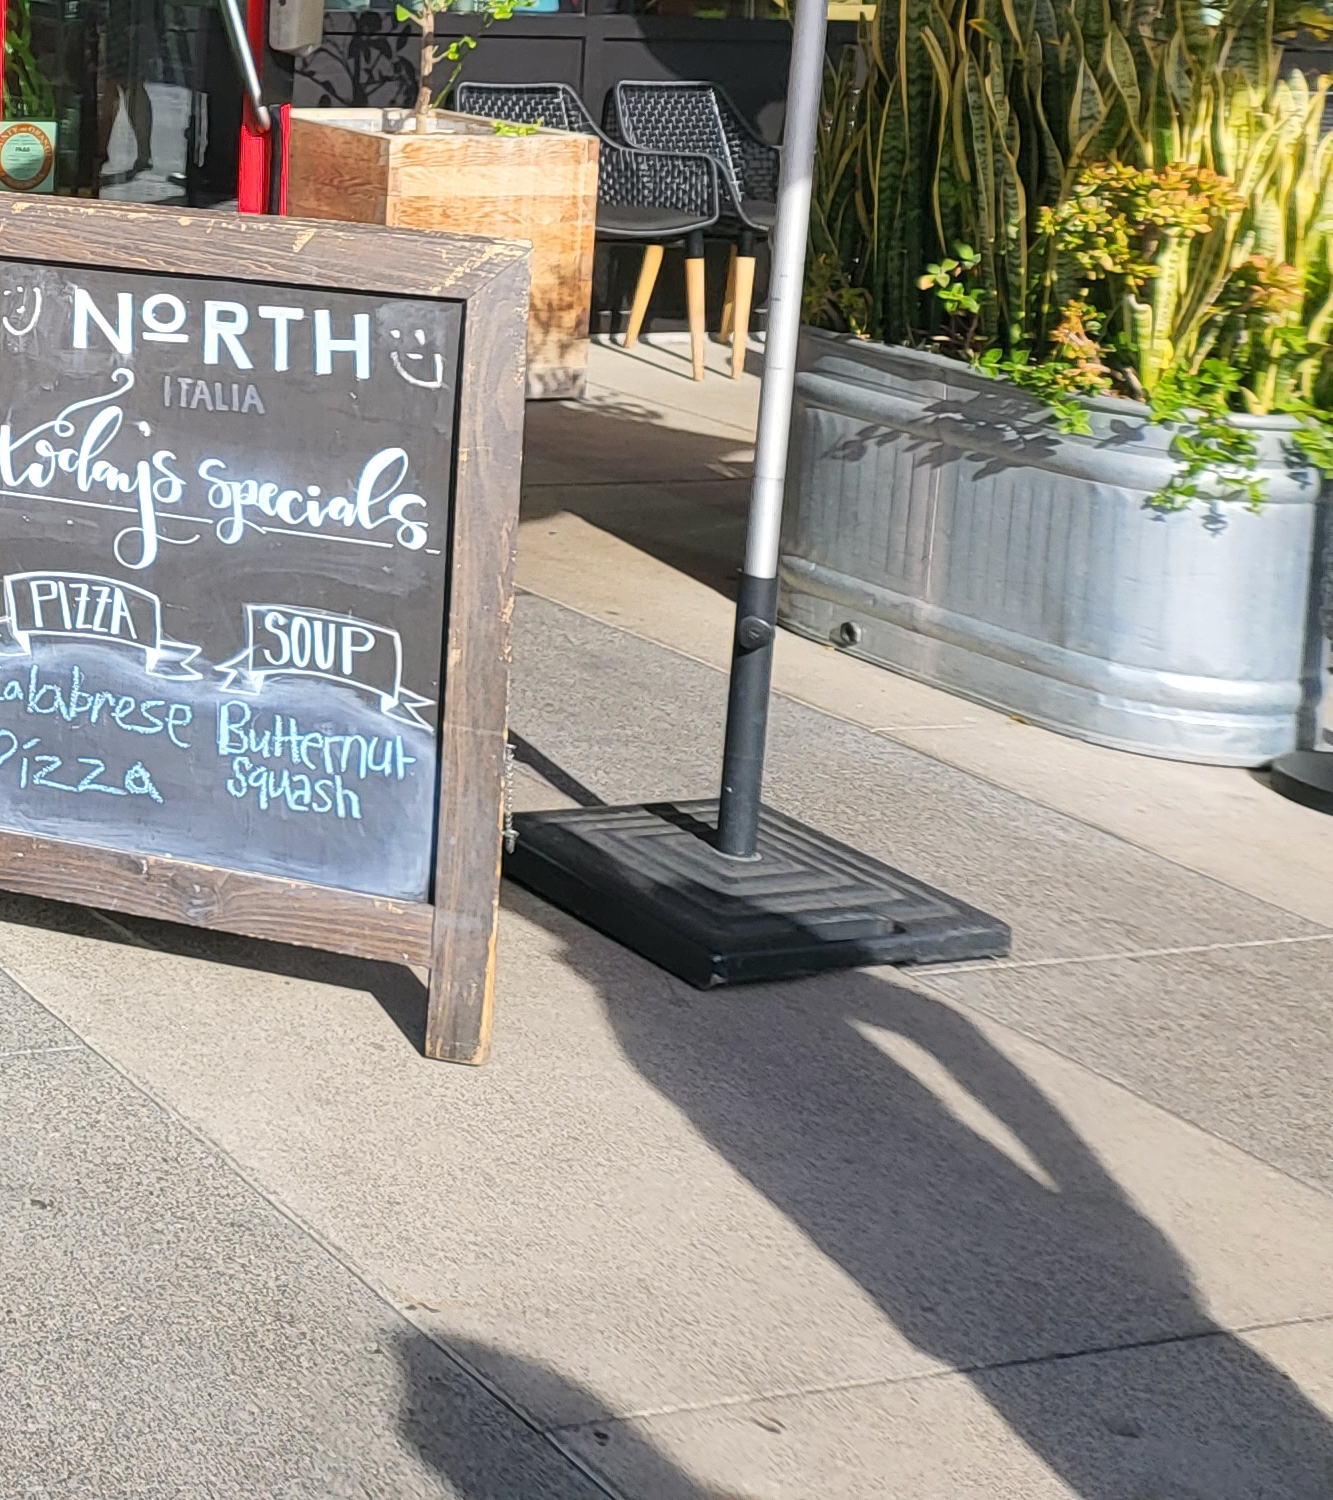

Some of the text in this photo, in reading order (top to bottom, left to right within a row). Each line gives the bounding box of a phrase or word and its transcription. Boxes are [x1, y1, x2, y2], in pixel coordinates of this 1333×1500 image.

[164, 375, 266, 415] ITALIA
[30, 579, 138, 640] PIZZA
[263, 612, 376, 675] SOUP
[219, 700, 417, 780] Butternut
